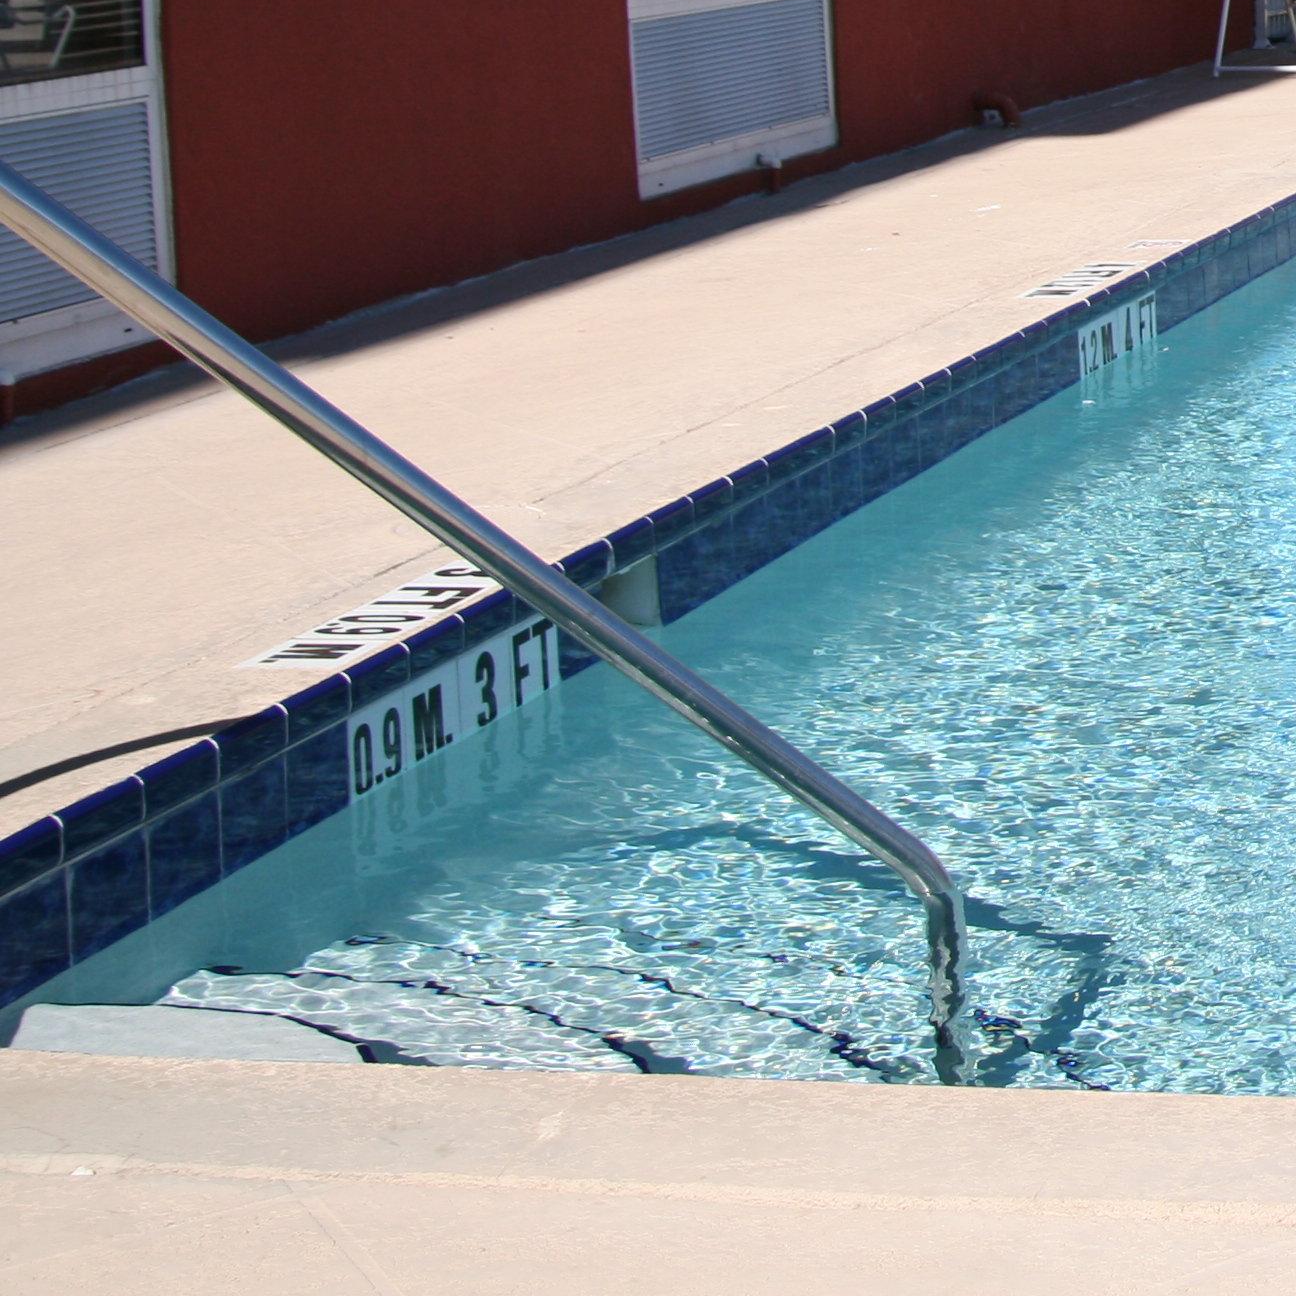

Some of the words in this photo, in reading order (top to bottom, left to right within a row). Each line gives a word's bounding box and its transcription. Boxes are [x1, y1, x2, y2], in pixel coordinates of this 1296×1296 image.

[1139, 293, 1155, 344] FT
[370, 587, 486, 610] FT
[475, 651, 498, 727] 3
[512, 618, 554, 707] FT
